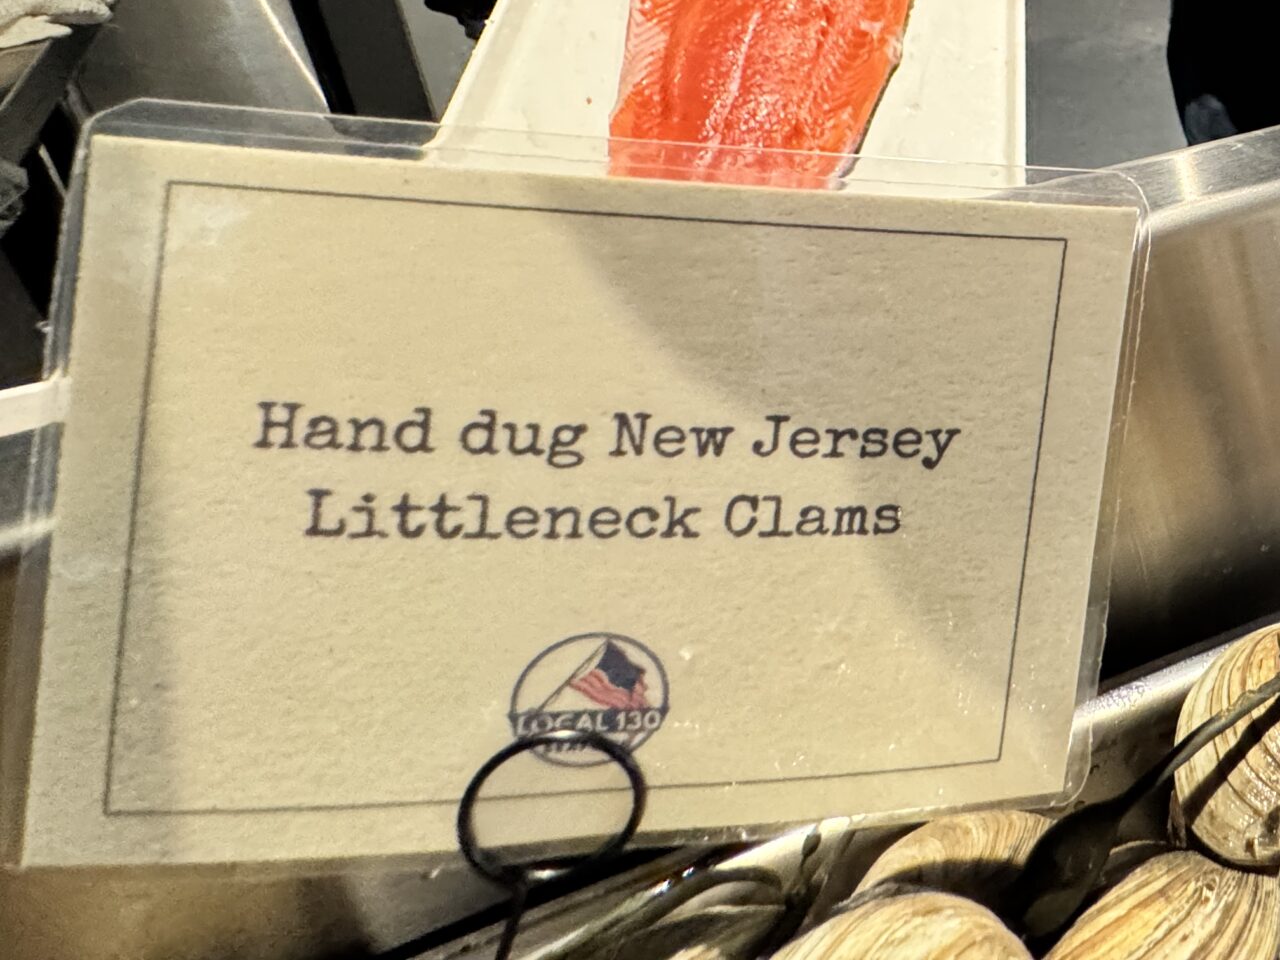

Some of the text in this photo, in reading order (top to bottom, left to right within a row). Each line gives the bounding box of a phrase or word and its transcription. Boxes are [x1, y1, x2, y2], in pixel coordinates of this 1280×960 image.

[253, 401, 962, 470] Hand dug New Jersey
[304, 488, 902, 540] Littleneck Clams
[516, 711, 662, 738] LOCAL 130
